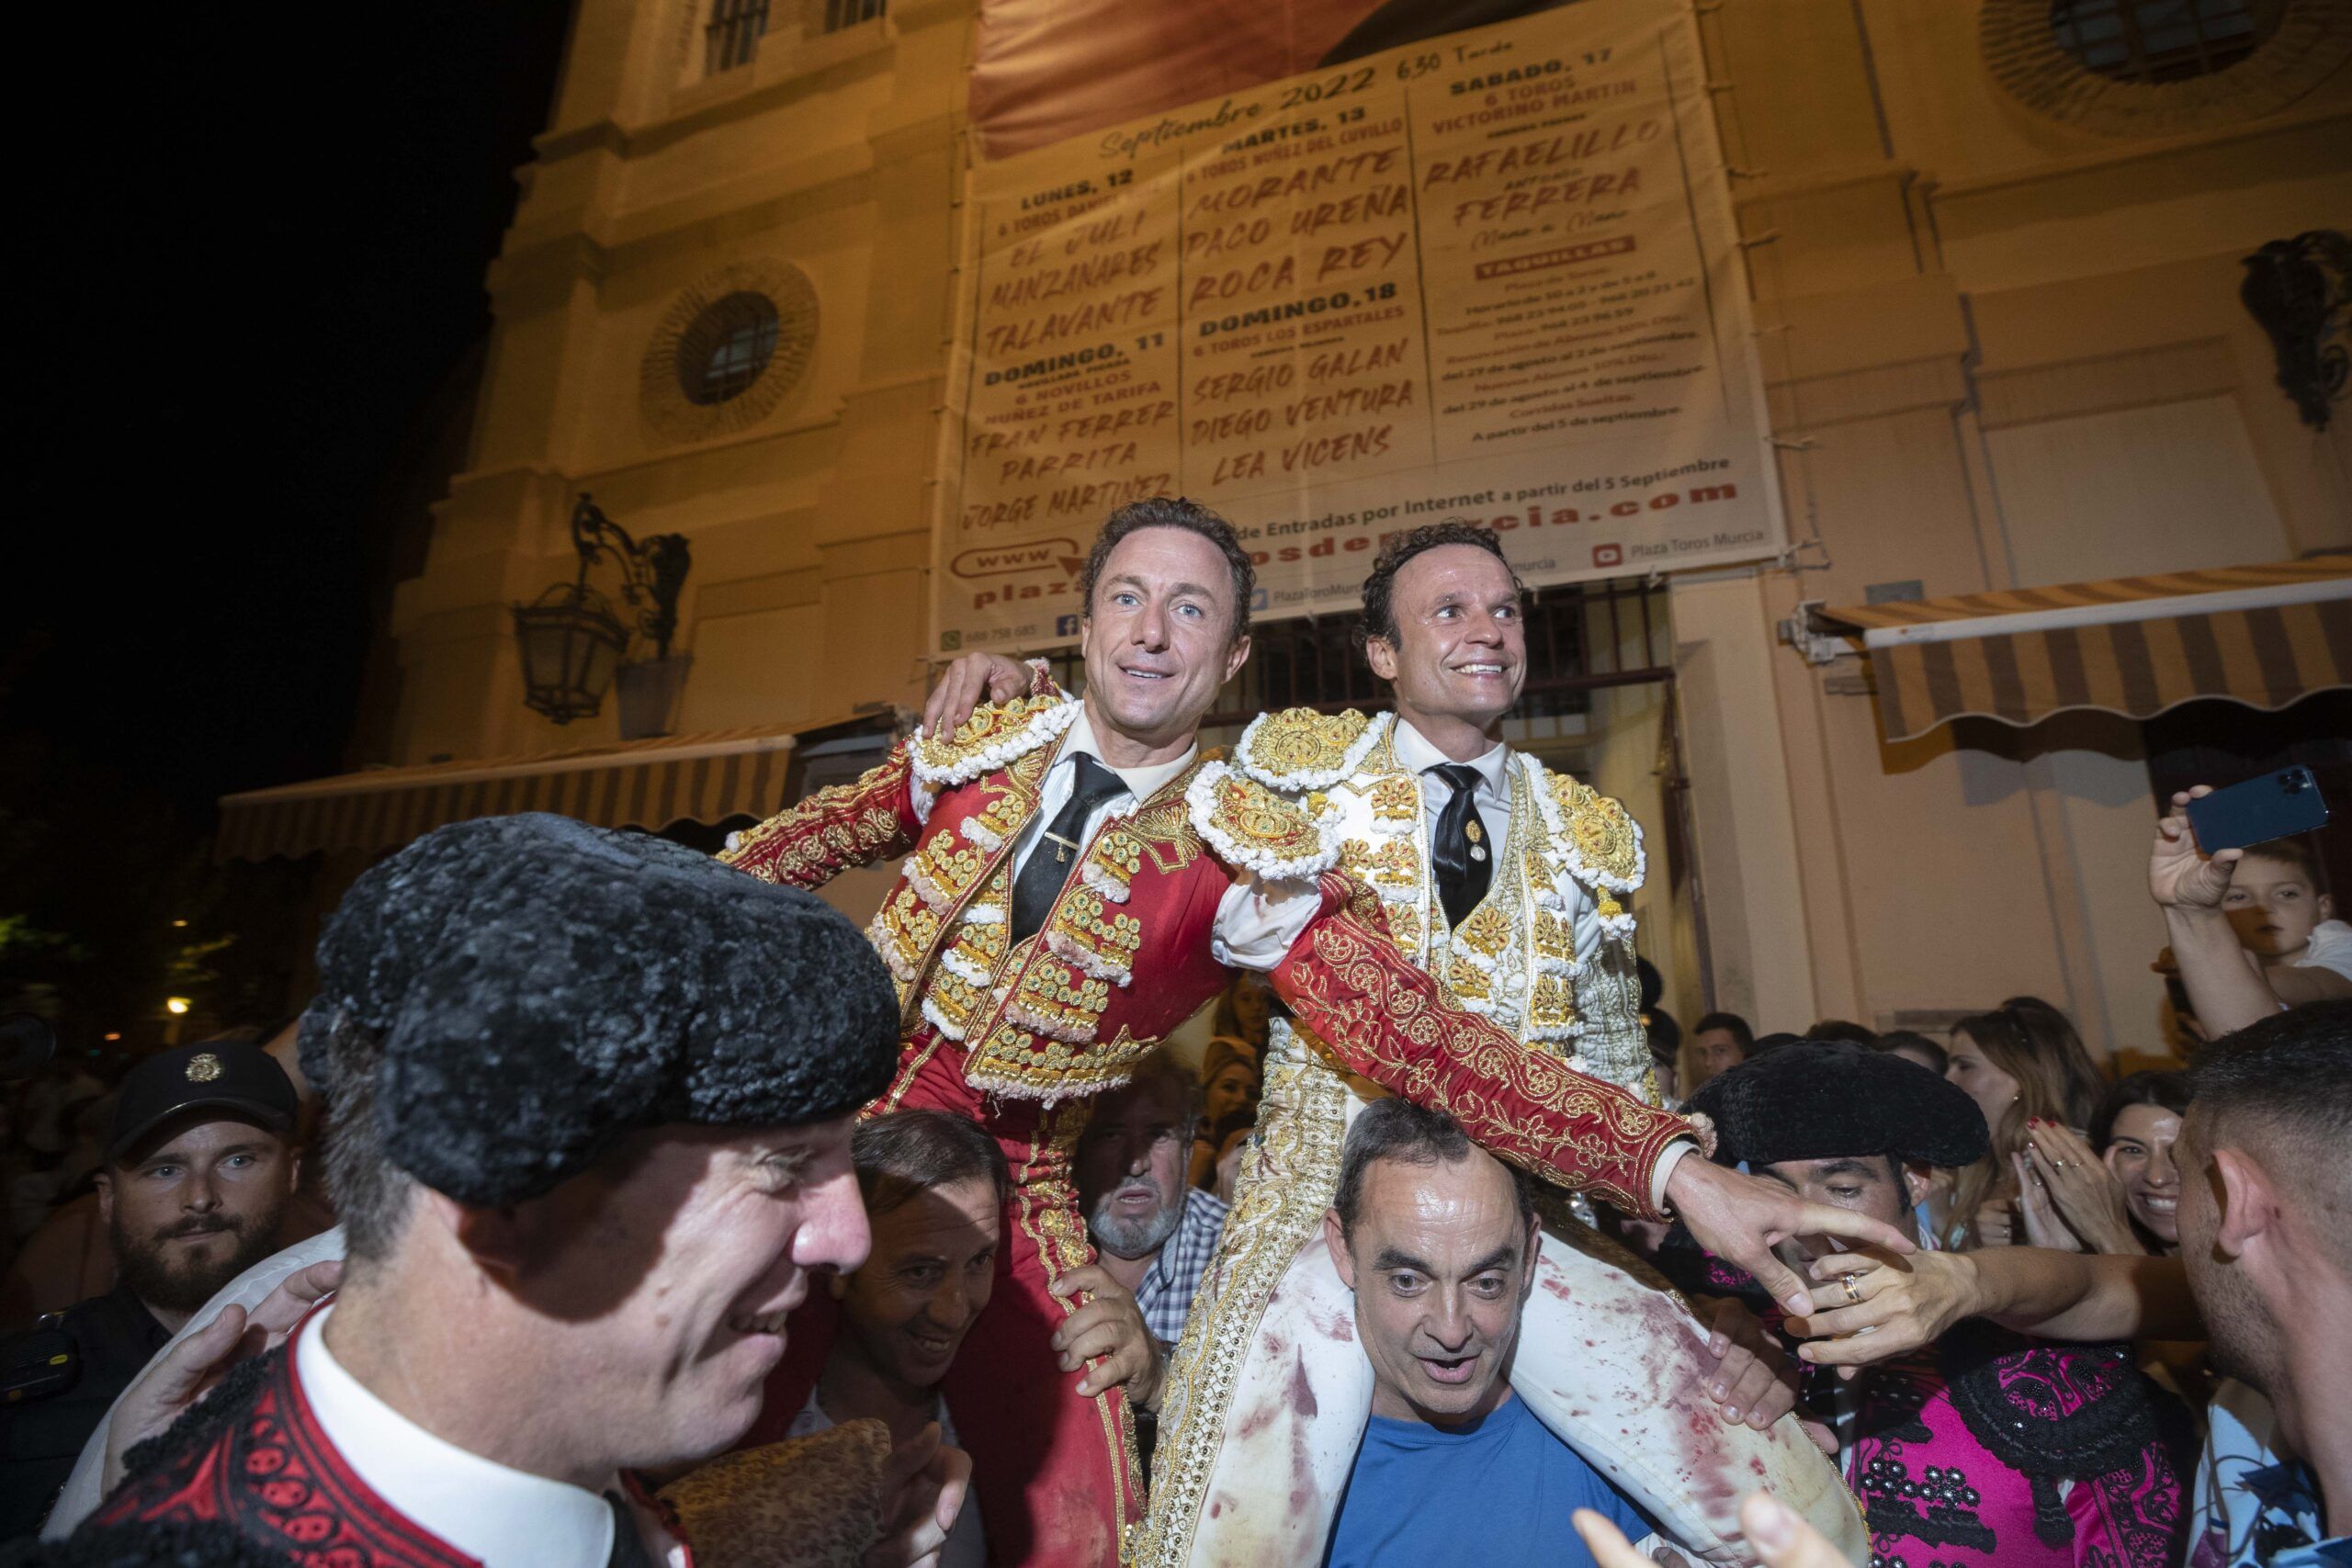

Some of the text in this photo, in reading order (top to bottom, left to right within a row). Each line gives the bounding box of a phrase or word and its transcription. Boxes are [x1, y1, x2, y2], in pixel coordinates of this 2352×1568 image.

[1581, 48, 1612, 65] 17
[1098, 99, 1261, 159] Septiembre
[1281, 66, 1376, 110] 2022
[1431, 100, 1544, 135] VICTORINO
[1553, 79, 1636, 107] MARTIN
[1485, 75, 1576, 107] 6 TOROS
[1337, 107, 1366, 125] 13
[1201, 155, 1247, 179] TOROS
[1306, 136, 1334, 154] DEL
[1339, 118, 1403, 145] CUVILLO
[1422, 119, 1661, 190] RAFAELILLO
[1106, 168, 1134, 188] 12
[1188, 145, 1404, 220] MORANTE
[1453, 166, 1640, 228] FERRERA
[1010, 209, 1146, 267] EL JULI
[1013, 209, 1060, 233] TOROS
[1186, 218, 1271, 262] PACO
[1471, 229, 1532, 252] Mano
[1566, 209, 1629, 232] Mano
[988, 238, 1163, 313] MANZANARES
[1189, 231, 1408, 310] ROCA REY
[1481, 240, 1627, 275] TAQUILLAS
[1466, 297, 1521, 315] Horario
[1523, 294, 1542, 303] de
[1600, 279, 1619, 288] de
[986, 287, 1163, 358] TALAVANTE
[1136, 332, 1164, 351] 11
[1211, 333, 1261, 355] TOROS
[1267, 326, 1295, 343] LOS
[1303, 305, 1405, 335] ESPARTALES
[1015, 369, 1131, 405] 6 NOVILLOS
[1193, 363, 1294, 405] SERGIO
[1307, 337, 1408, 386] GALAN
[1442, 369, 1464, 382] del
[1508, 355, 1557, 371] agosto
[1057, 398, 1082, 412] DE
[1092, 380, 1161, 406] TARIFA
[1191, 378, 1413, 446] DIEGO VENTURA
[1442, 401, 1465, 414] del
[1510, 387, 1559, 403] agosto
[1510, 400, 1574, 419] Corridas
[971, 400, 1174, 458] FRAN FERRER
[1472, 432, 1485, 442] A
[1486, 425, 1528, 441] partir
[1531, 420, 1555, 433] del
[1570, 416, 1589, 427] de
[1000, 441, 1137, 485] PARRITA
[1211, 423, 1393, 487] LEA VICENS
[962, 473, 1171, 531] JORGE MARTINEZ
[1266, 513, 1356, 536] Entradas
[1363, 505, 1399, 525] por
[1405, 488, 1496, 514] Internet
[1501, 491, 1512, 502] a
[1517, 481, 1567, 502] partir
[1572, 477, 1600, 493] del
[1604, 476, 1615, 490] 5
[1621, 457, 1730, 488] Septiembre
[977, 548, 1050, 568] www
[1631, 529, 1764, 558] Plaza Toros Murcia
